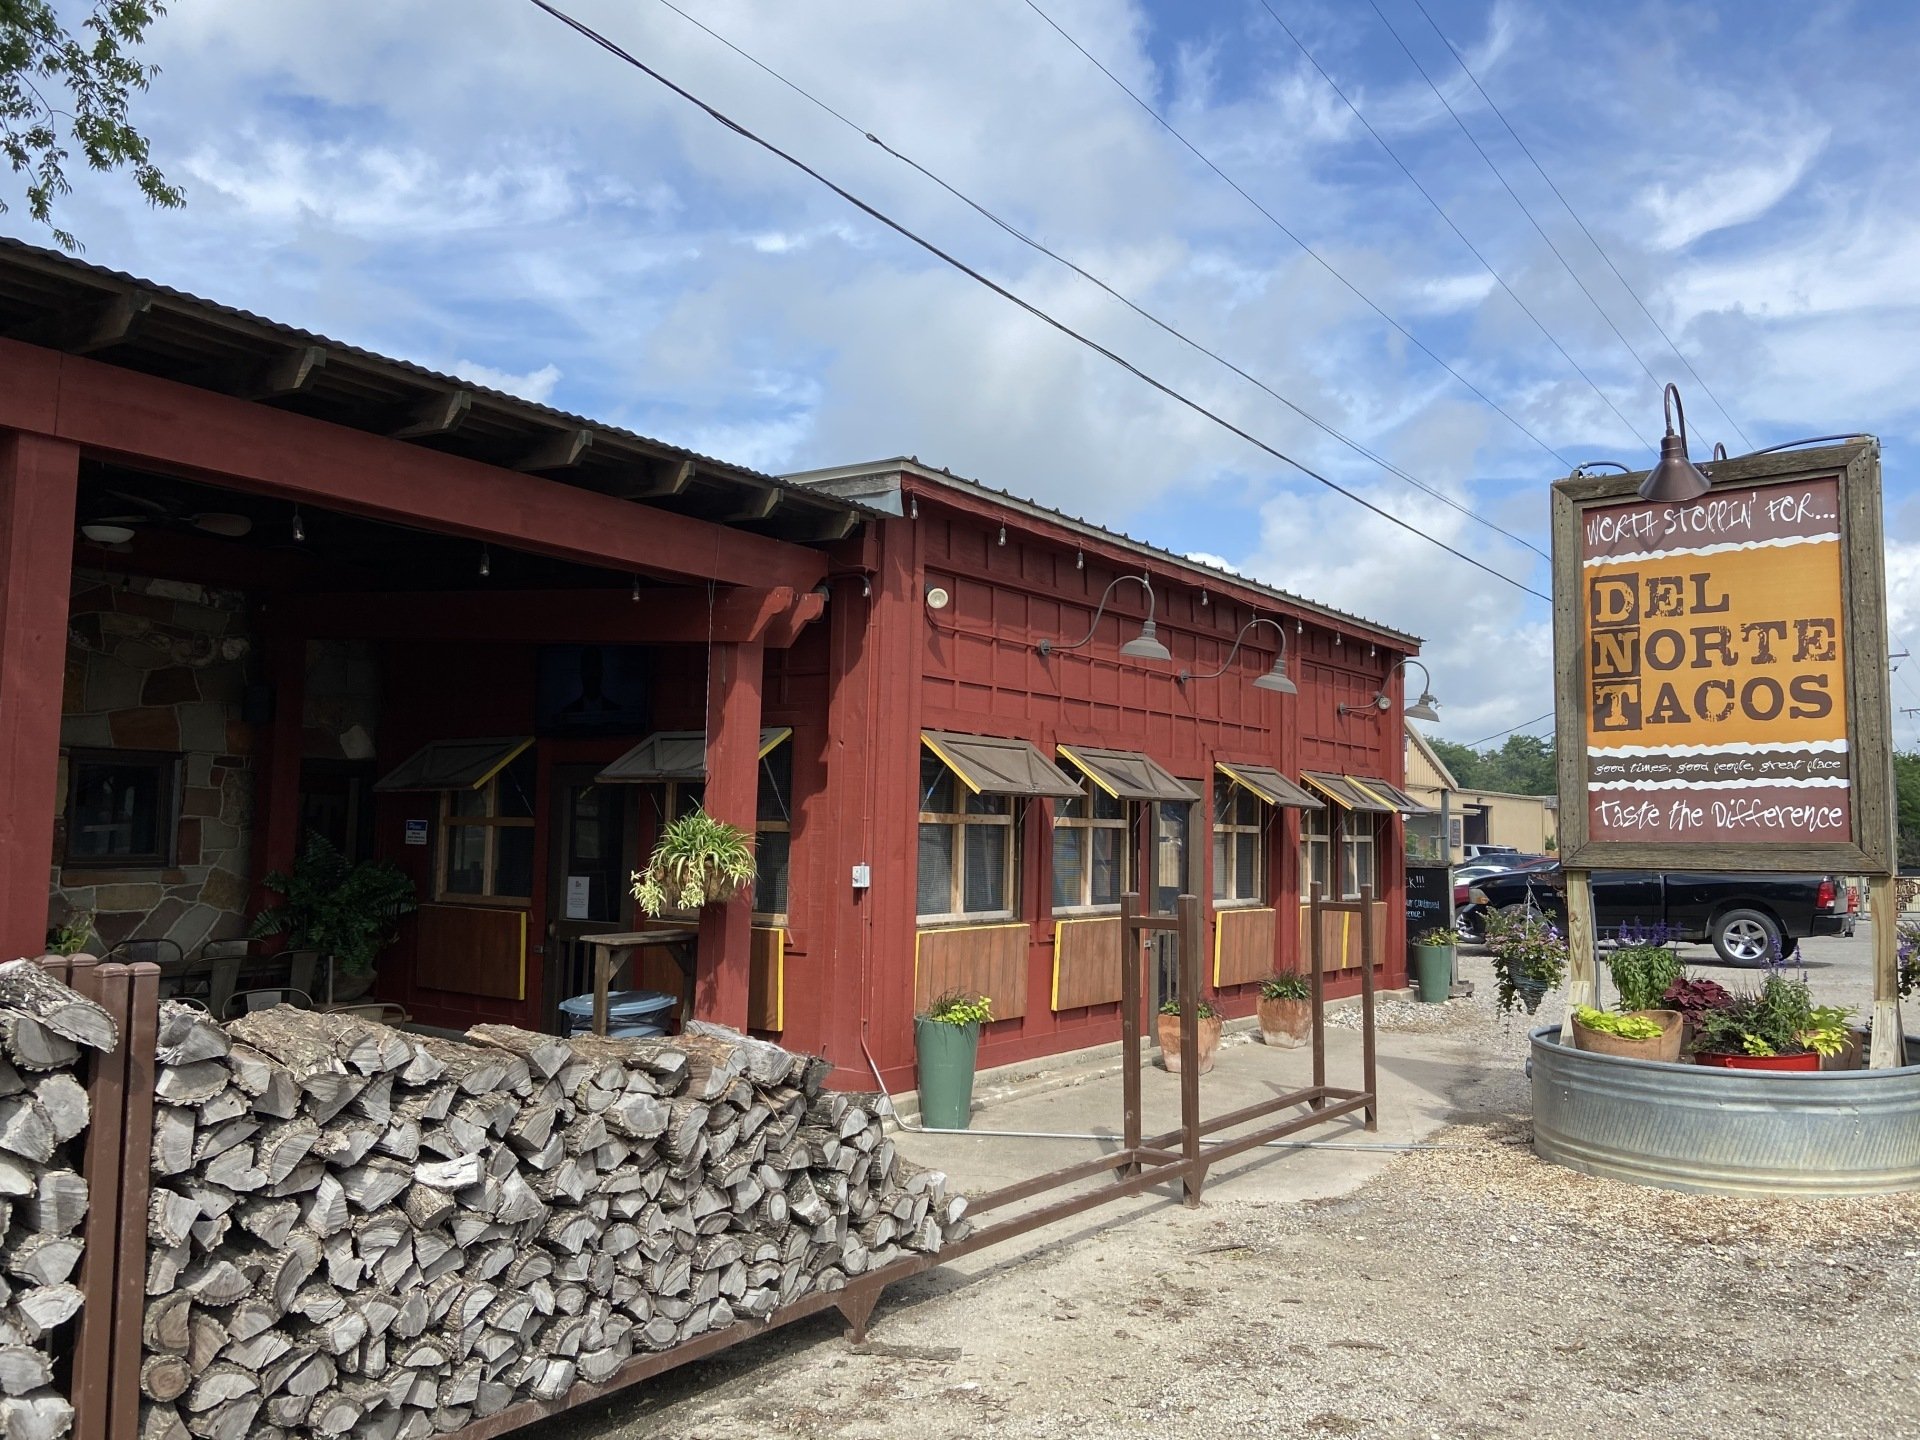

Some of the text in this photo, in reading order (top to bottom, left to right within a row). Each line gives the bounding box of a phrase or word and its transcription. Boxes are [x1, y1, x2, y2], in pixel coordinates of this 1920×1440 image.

[1587, 492, 1836, 546] WORTH STOPPIN' FOR...
[1592, 572, 1730, 625] DEL
[1592, 617, 1836, 676] NORTE
[1593, 673, 1833, 729] TACOS
[1594, 763, 1625, 775] good
[1676, 761, 1709, 774] good
[1714, 759, 1754, 774] people,
[1759, 759, 1806, 773] great
[1806, 758, 1842, 773] place
[1595, 798, 1843, 832] Taste the Difference
